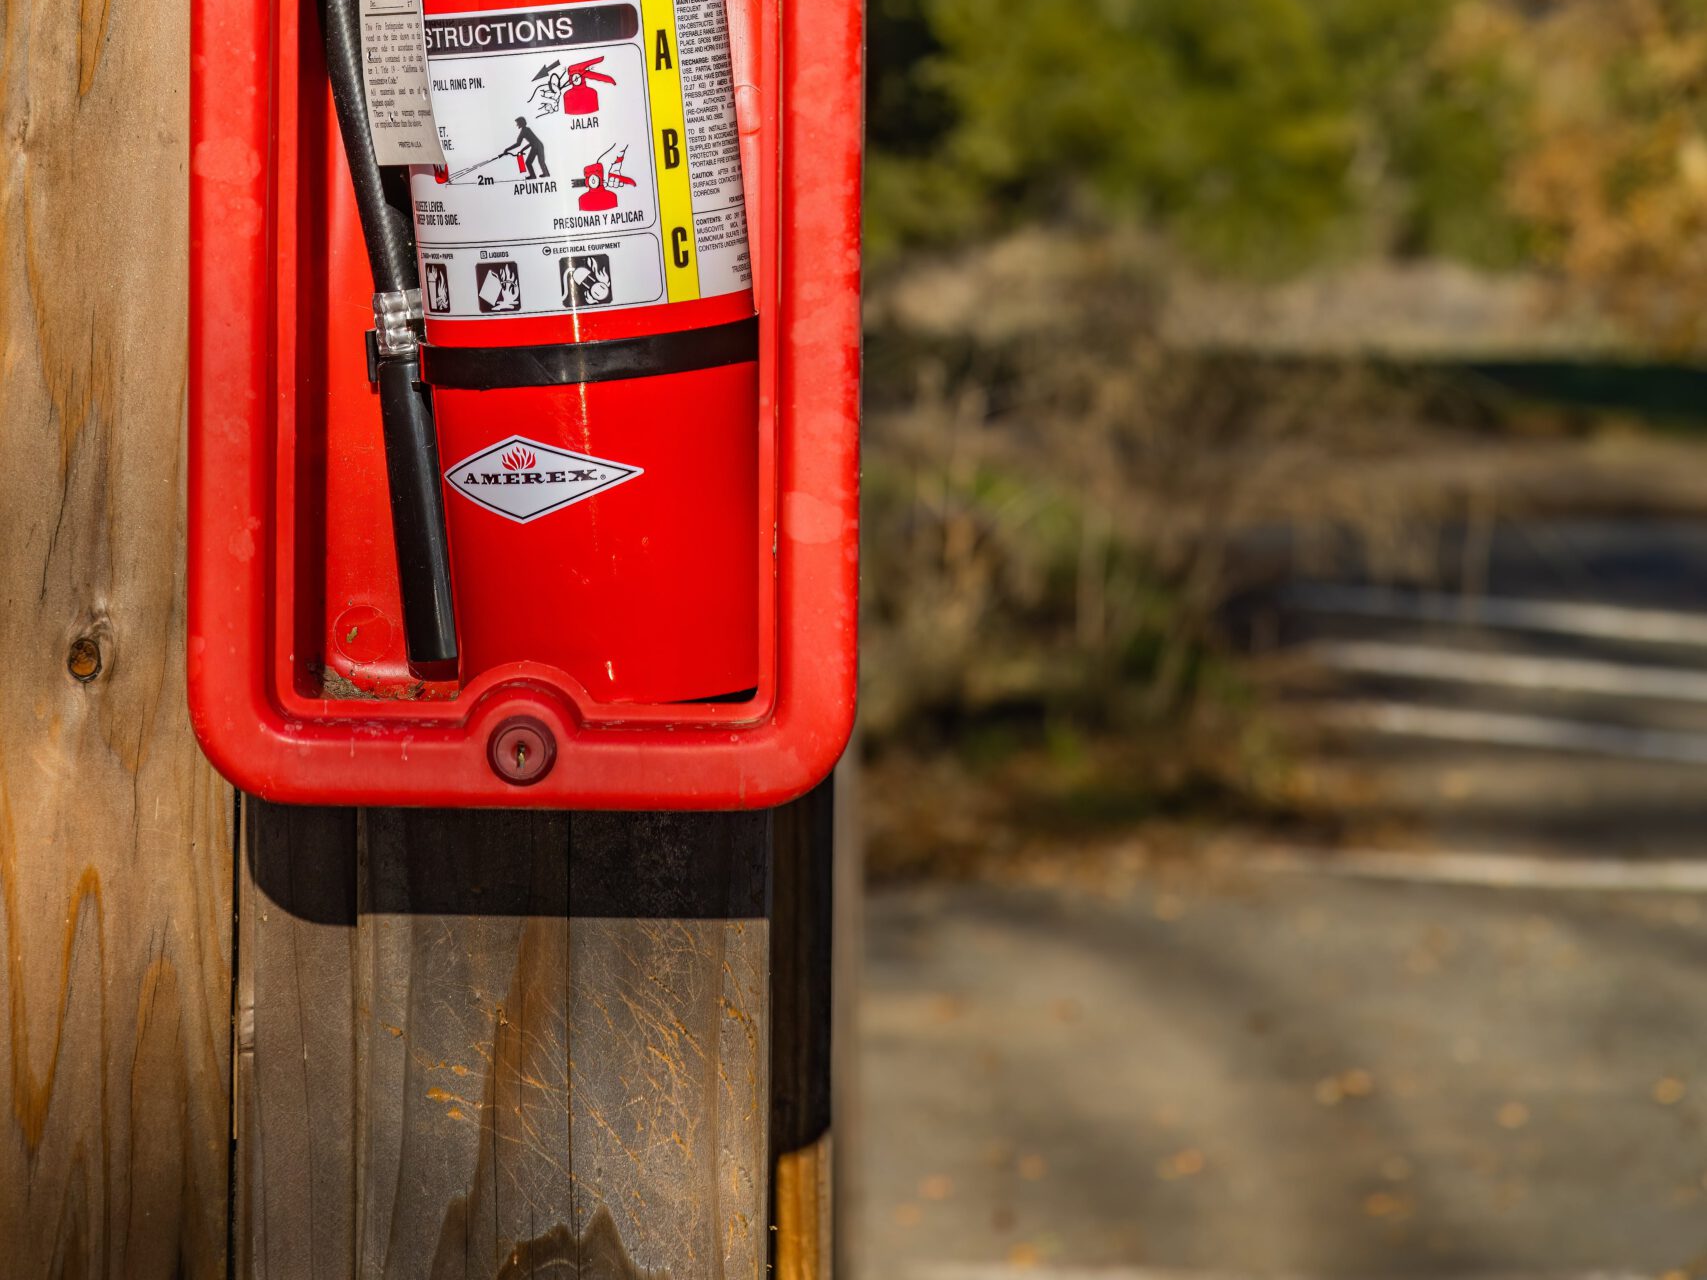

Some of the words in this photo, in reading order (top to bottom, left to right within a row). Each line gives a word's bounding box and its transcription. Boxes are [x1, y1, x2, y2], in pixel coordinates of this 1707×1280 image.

[425, 17, 573, 49] STRUCTIONS
[655, 29, 673, 70] A
[432, 79, 449, 91] PULL
[450, 78, 467, 90] RING
[468, 77, 485, 90] PIN.
[570, 117, 599, 130] JALAR
[662, 128, 680, 170] B
[689, 143, 711, 151] SUPPLIED
[690, 150, 718, 159] PROTECTION
[478, 175, 494, 185] 2m
[693, 179, 717, 188] SURFACES
[513, 182, 557, 195] APUNTAR
[429, 201, 445, 212] LEVER.
[436, 215, 444, 225] TO
[444, 214, 460, 225] SIDE.
[553, 215, 600, 230] PRESIONAR
[603, 214, 608, 225] Y
[611, 210, 644, 224] APLICAR
[696, 216, 722, 225] CONTENTS:
[698, 234, 724, 243] AMMONIUM
[552, 245, 585, 254] ELECTRICAL
[588, 242, 620, 251] EQUIPMENT
[672, 226, 689, 269] C
[699, 243, 724, 252] CONTENTS
[464, 469, 597, 484] AMEREX
